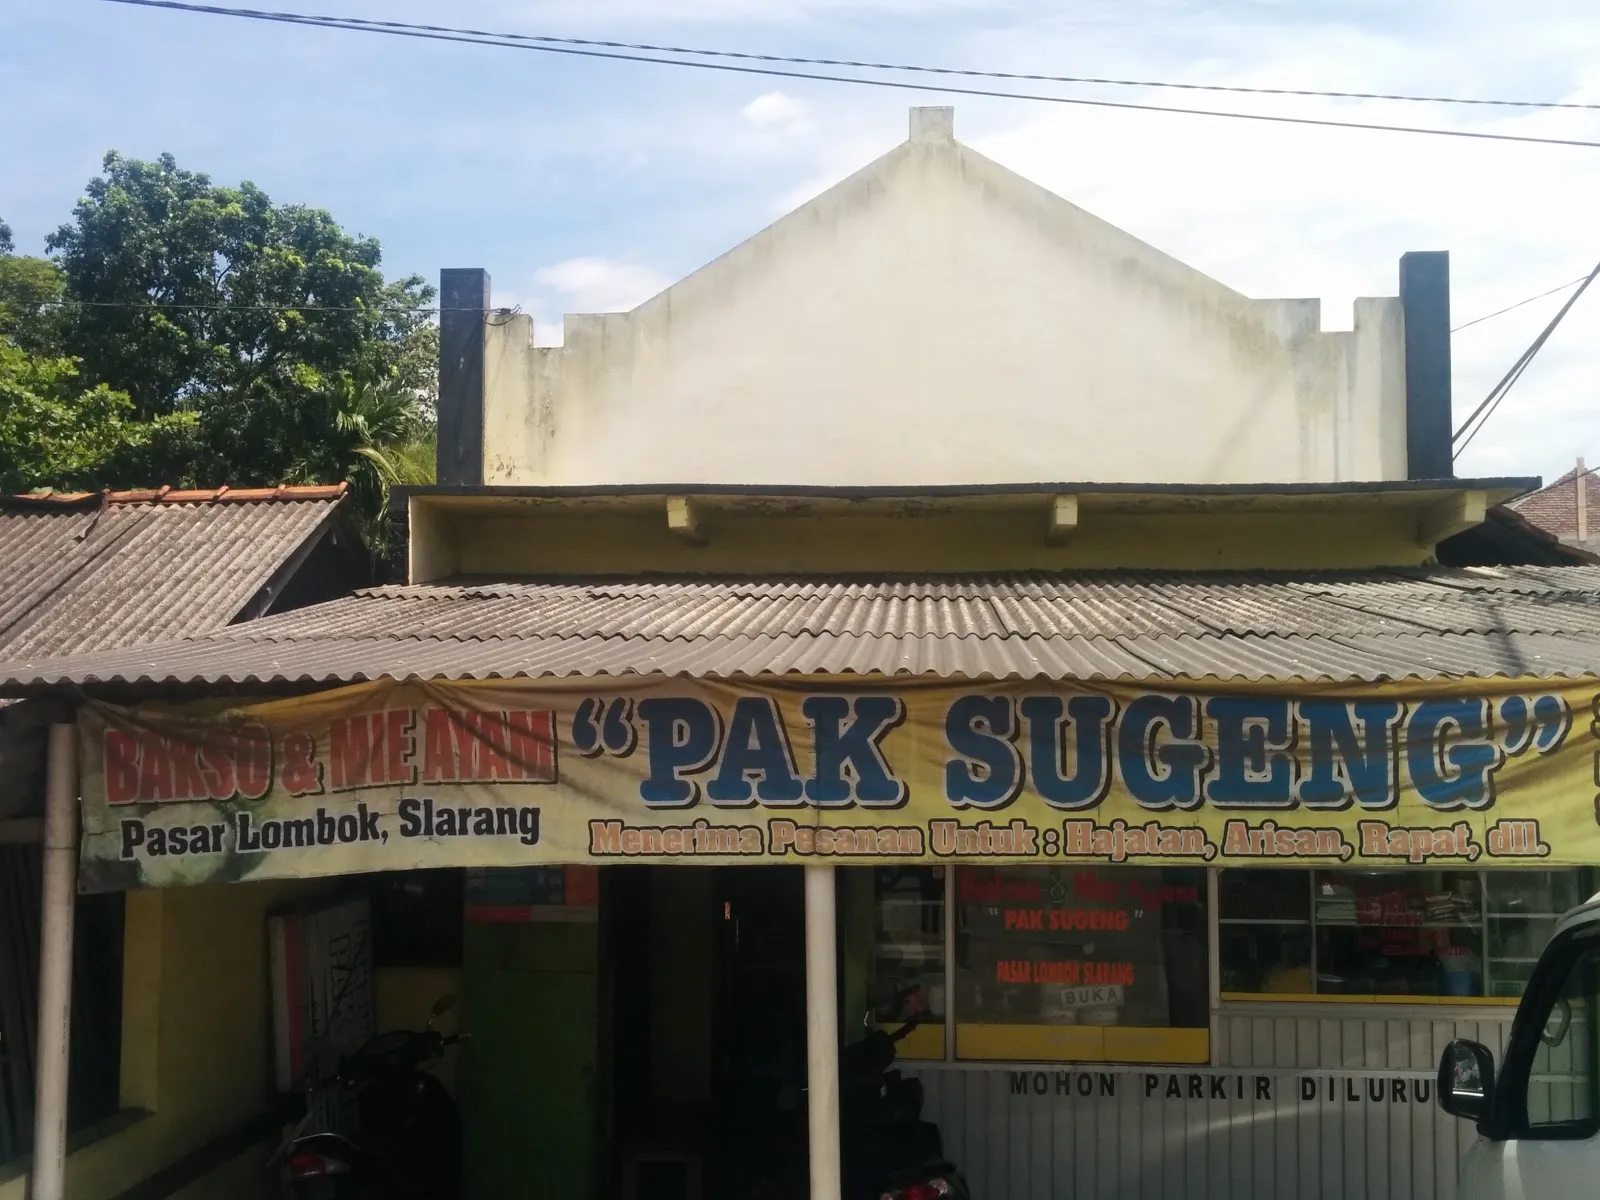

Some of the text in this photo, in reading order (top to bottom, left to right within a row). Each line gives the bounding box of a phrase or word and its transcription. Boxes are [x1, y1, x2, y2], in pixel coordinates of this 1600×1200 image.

[104, 709, 559, 806] BAKSO & MIE AYAM
[121, 798, 541, 859] Pasar Lombok, Slarang
[589, 818, 763, 857] Menerima
[768, 818, 925, 858] Pesanan
[1063, 818, 1217, 863] Hajatan,
[1223, 819, 1352, 862] Arisan,
[1358, 819, 1481, 864] Rapat,
[1486, 819, 1551, 858] dll.
[1065, 987, 1119, 1004] BUKA
[1010, 1071, 1116, 1097] MOHON
[1145, 1074, 1272, 1101] PARKIR
